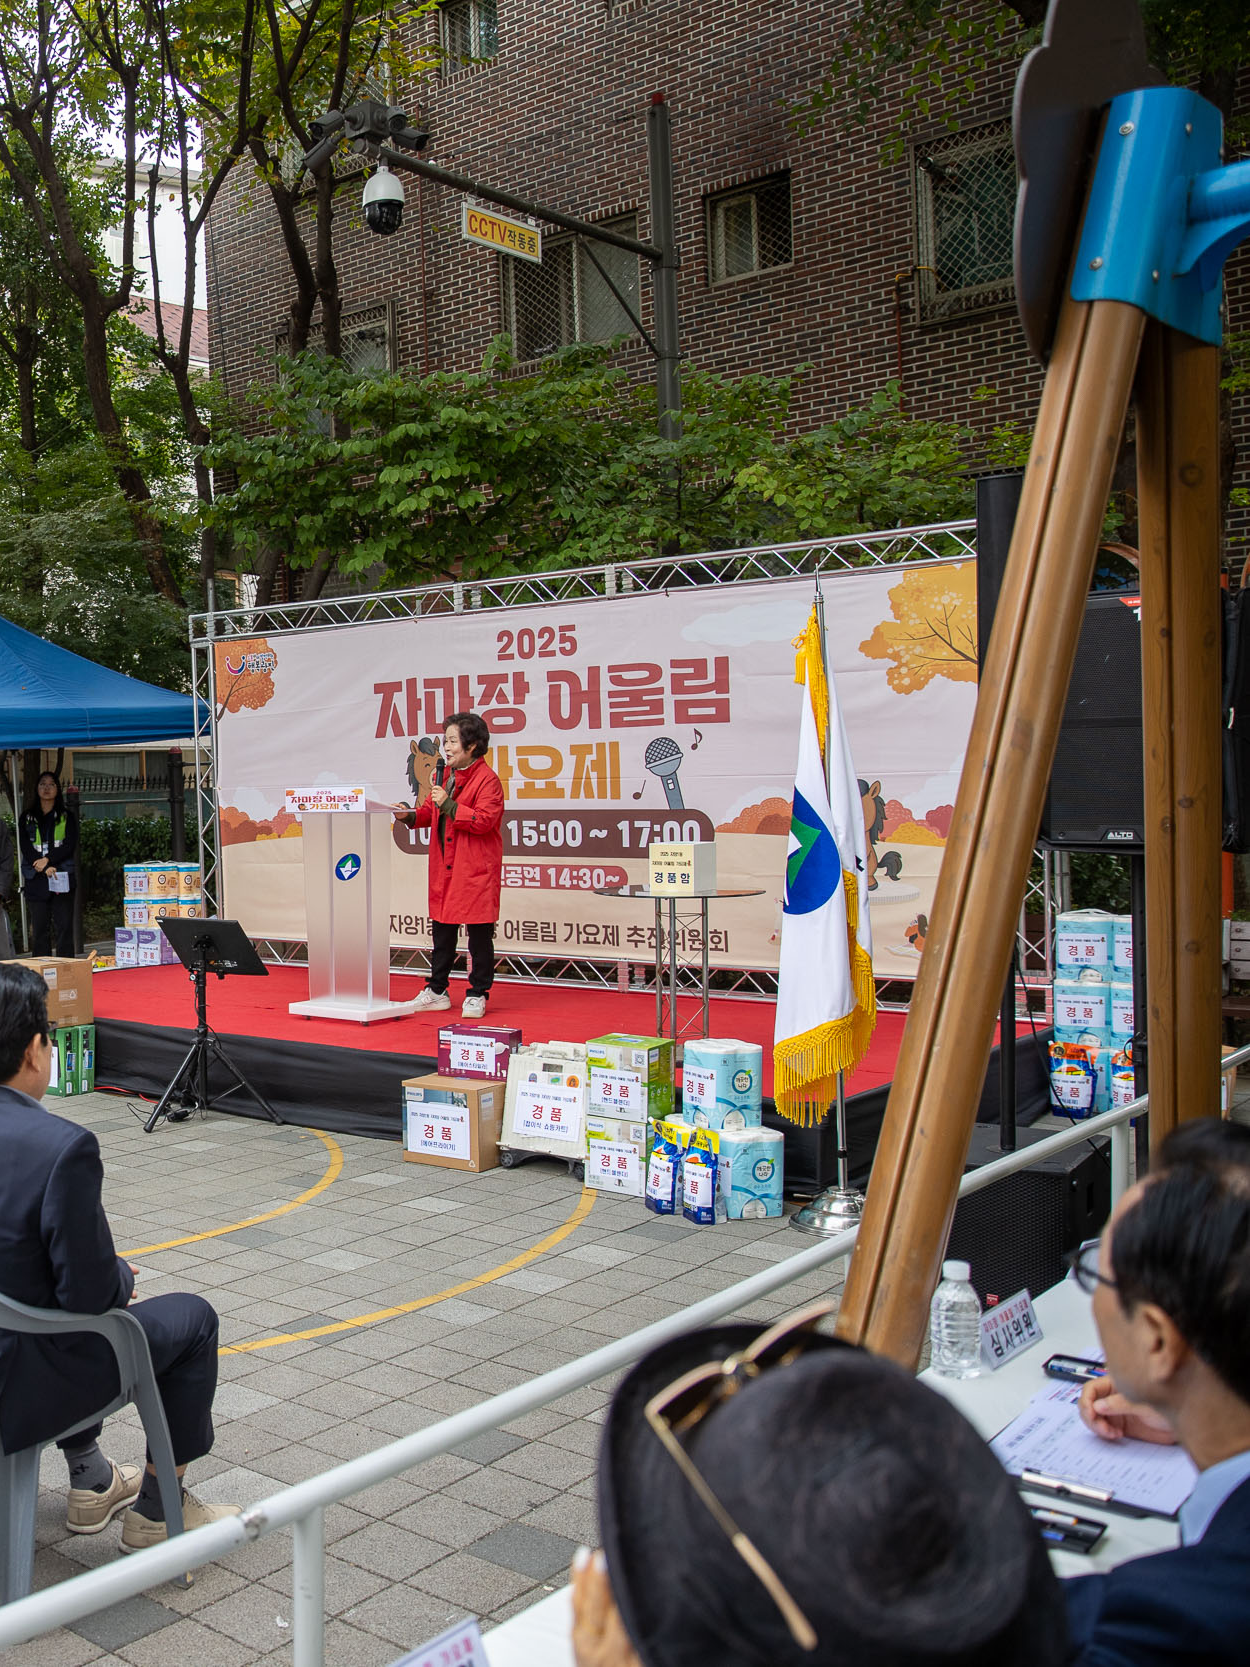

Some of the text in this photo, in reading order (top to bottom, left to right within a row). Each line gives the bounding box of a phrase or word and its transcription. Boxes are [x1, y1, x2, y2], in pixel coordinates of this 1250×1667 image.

[497, 624, 578, 661] 2025
[374, 656, 731, 739] 자마장 어울림
[290, 796, 323, 804] 자마장
[506, 819, 583, 848] 15:00
[616, 819, 701, 848] 17:00
[1106, 831, 1134, 840] ALTO
[504, 919, 557, 943] 어울림
[563, 921, 620, 947] 가요제
[990, 1312, 1036, 1357] 심사위원
